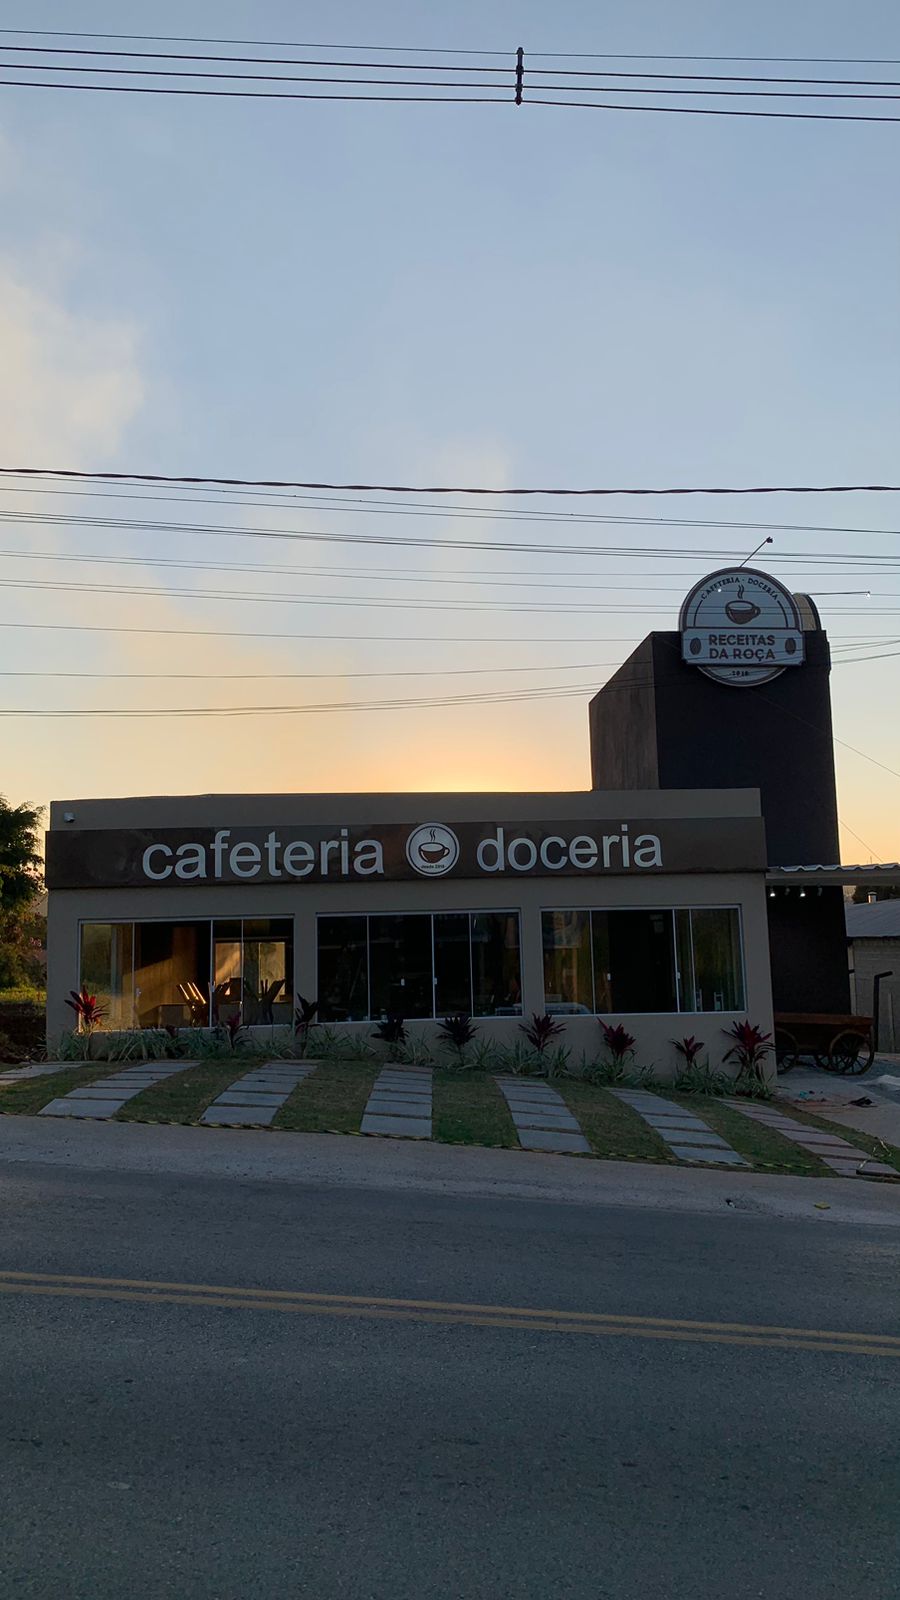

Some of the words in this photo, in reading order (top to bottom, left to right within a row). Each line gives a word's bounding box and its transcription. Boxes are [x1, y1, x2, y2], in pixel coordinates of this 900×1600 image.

[701, 577, 740, 600] CAFETERIA
[747, 577, 779, 601] DOCERIA
[708, 634, 776, 647] RECEITAS
[709, 648, 729, 660] DA
[733, 648, 776, 662] ROÇA
[141, 829, 385, 881] cafeteria
[476, 824, 663, 872] doceria
